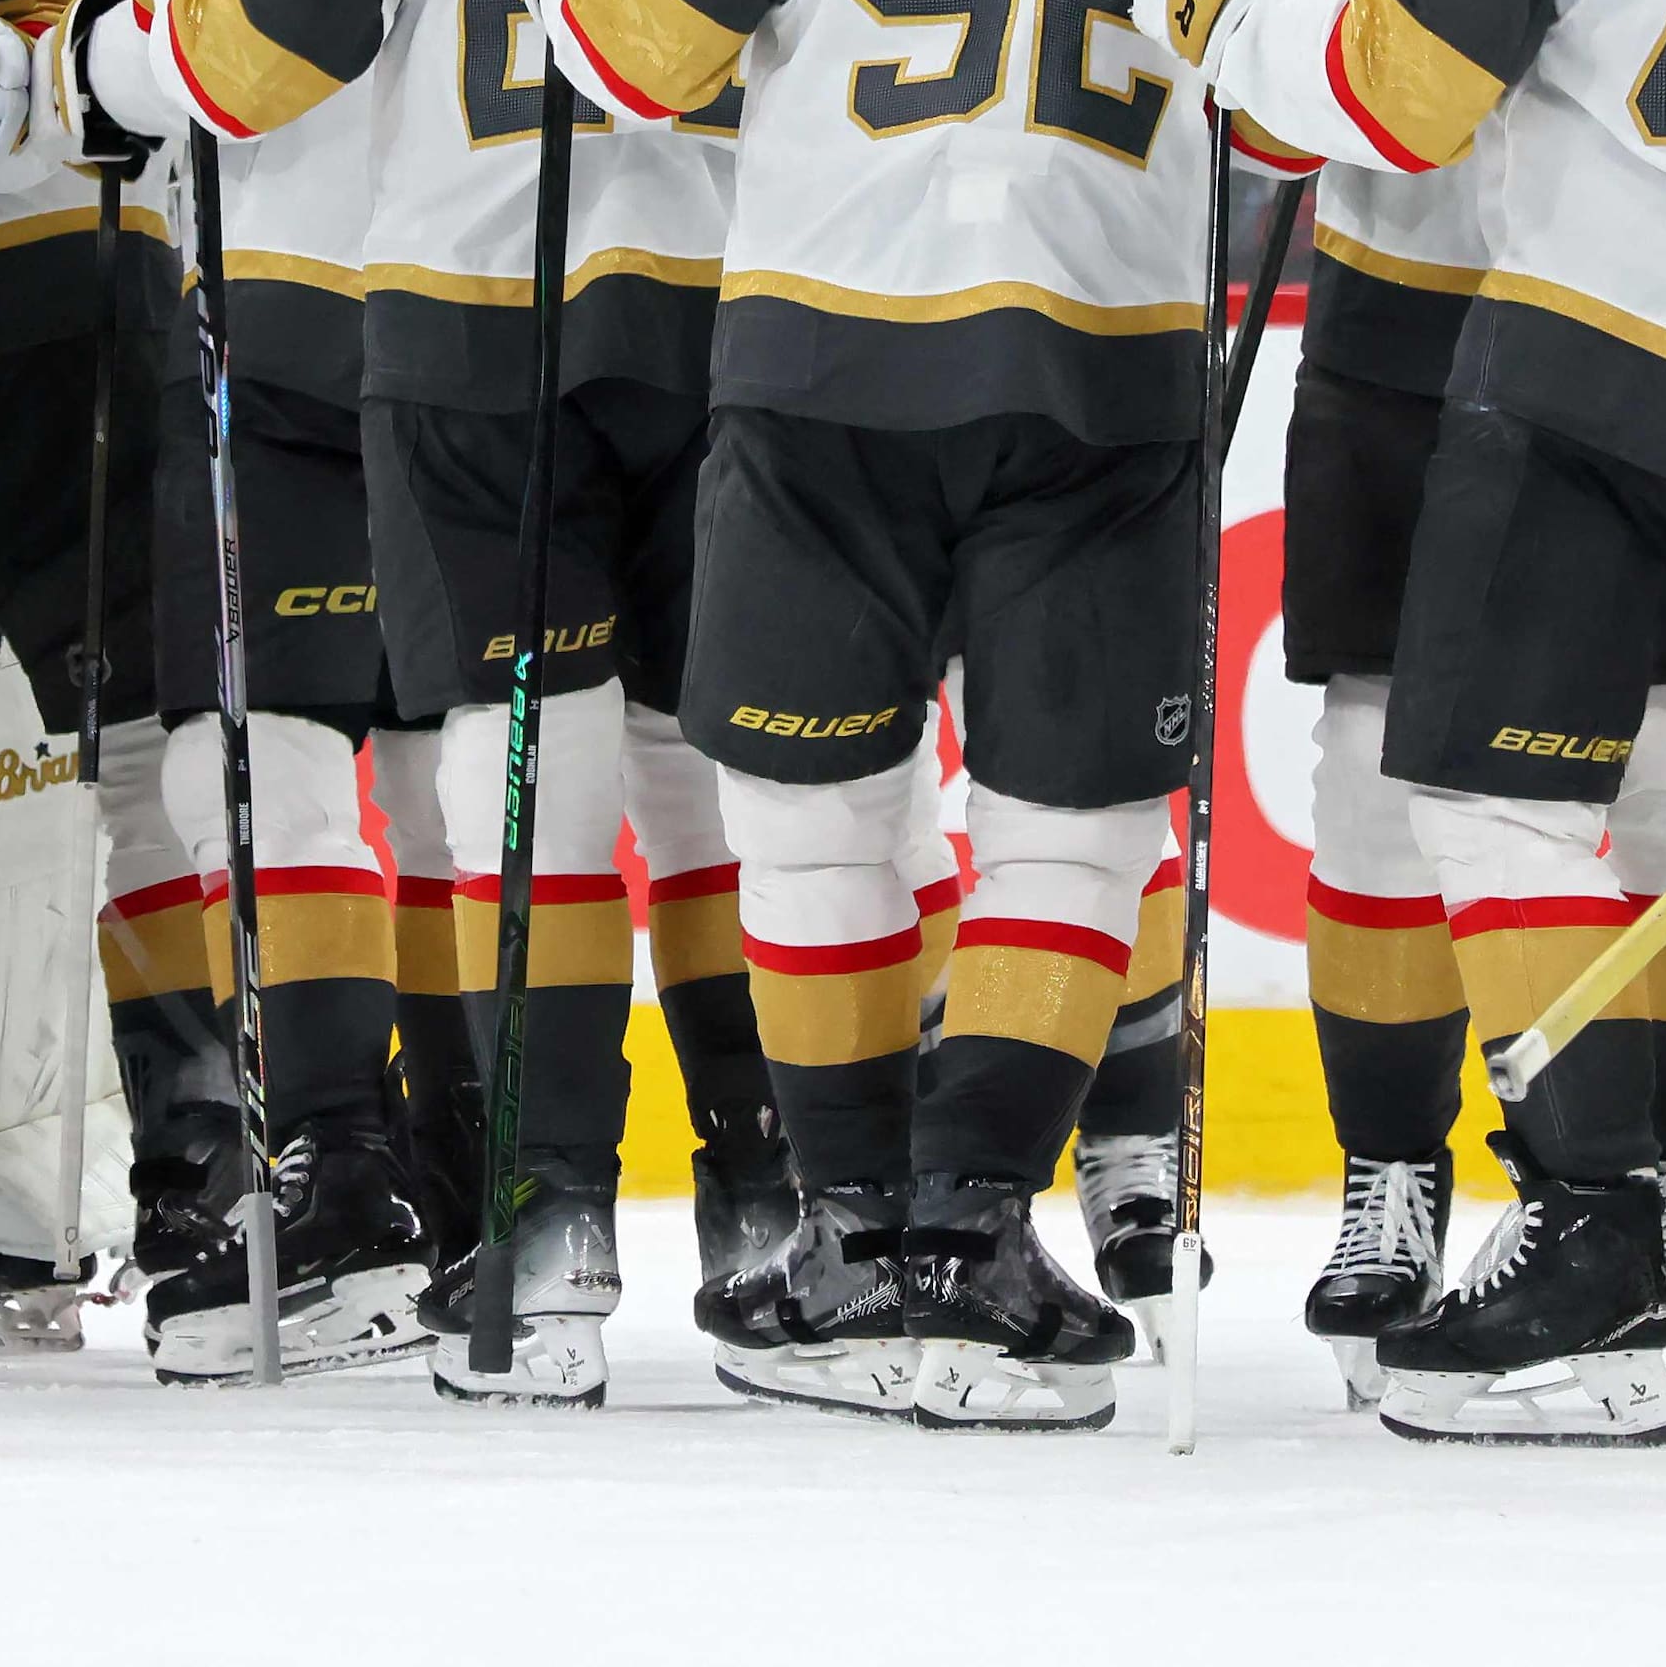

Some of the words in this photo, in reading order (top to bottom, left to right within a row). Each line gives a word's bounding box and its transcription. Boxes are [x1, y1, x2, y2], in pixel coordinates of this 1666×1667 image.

[225, 538, 240, 624] BAUER
[275, 586, 376, 617] CC
[483, 616, 616, 660] BUE
[729, 705, 899, 740] BAUER
[1489, 727, 1631, 764] BAUER
[505, 686, 527, 852] BAUER
[238, 802, 250, 846] THEODORE
